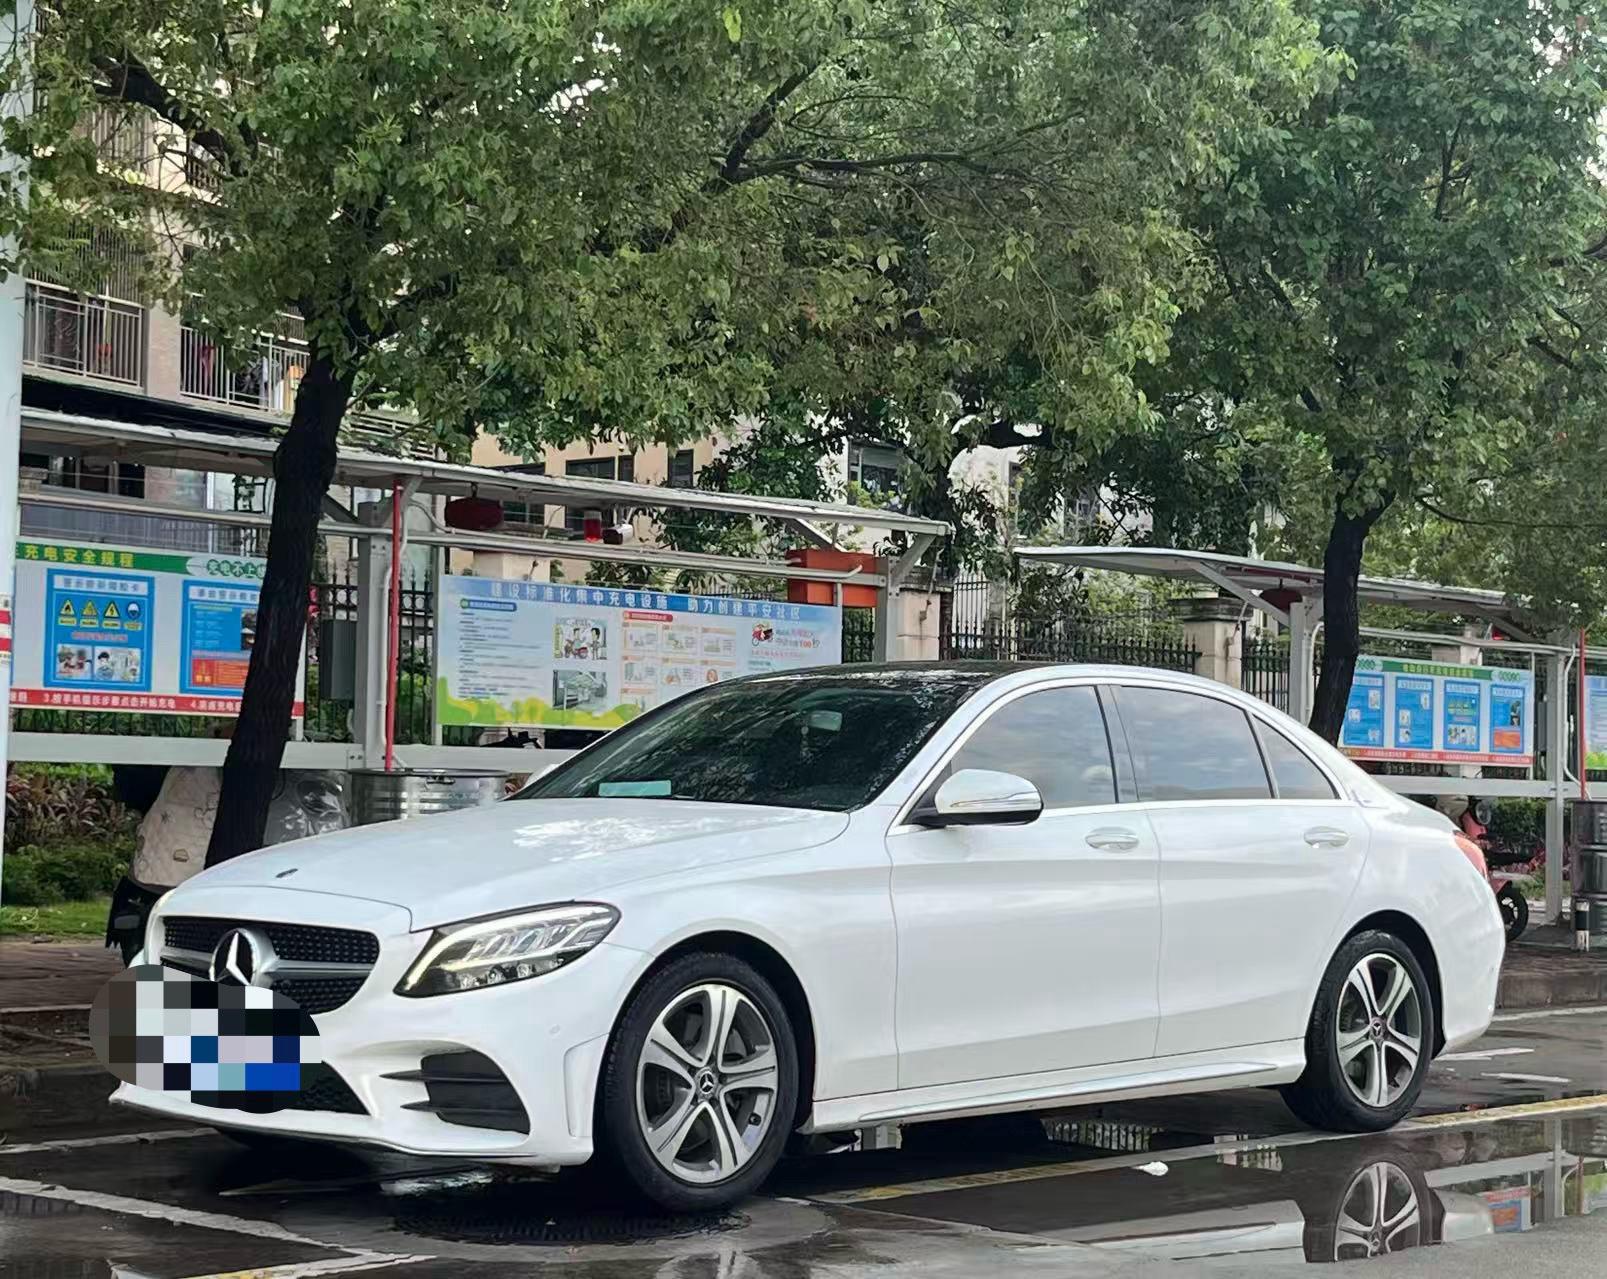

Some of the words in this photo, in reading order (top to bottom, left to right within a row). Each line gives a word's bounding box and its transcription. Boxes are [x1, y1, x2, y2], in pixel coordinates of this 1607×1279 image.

[16, 544, 134, 568] 充电安全规程
